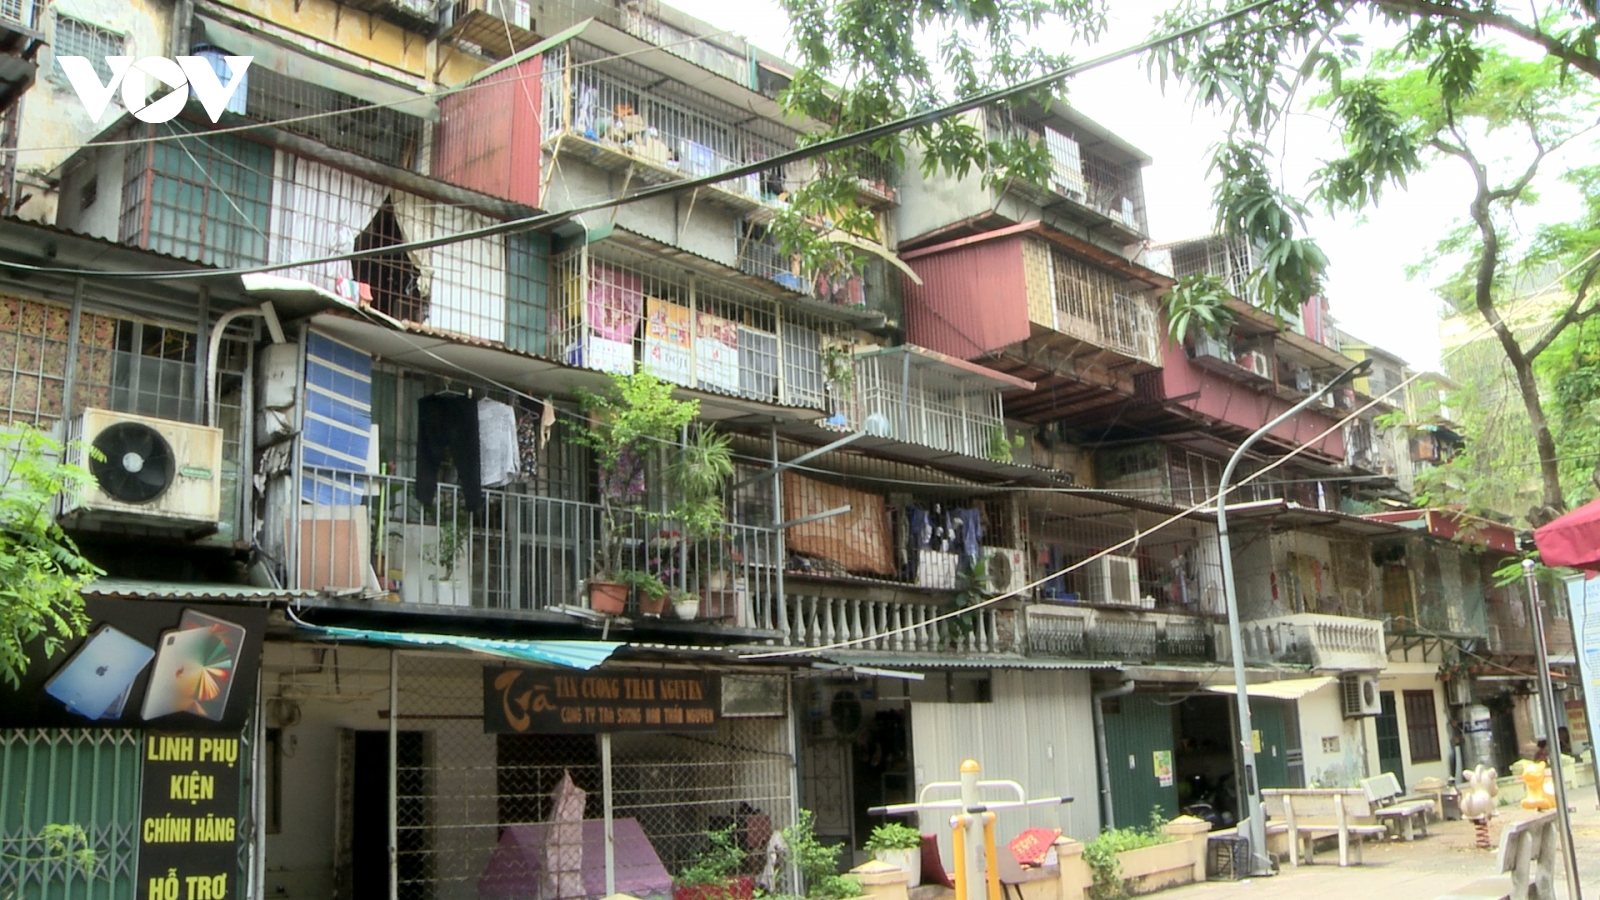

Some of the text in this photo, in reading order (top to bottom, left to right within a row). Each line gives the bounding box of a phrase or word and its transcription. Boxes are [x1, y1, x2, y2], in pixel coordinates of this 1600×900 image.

[147, 736, 238, 767] LINH PHỤ
[170, 770, 214, 805] KIỆN
[143, 813, 236, 843] CHÍNH HÃNG
[149, 867, 179, 900] HỖ
